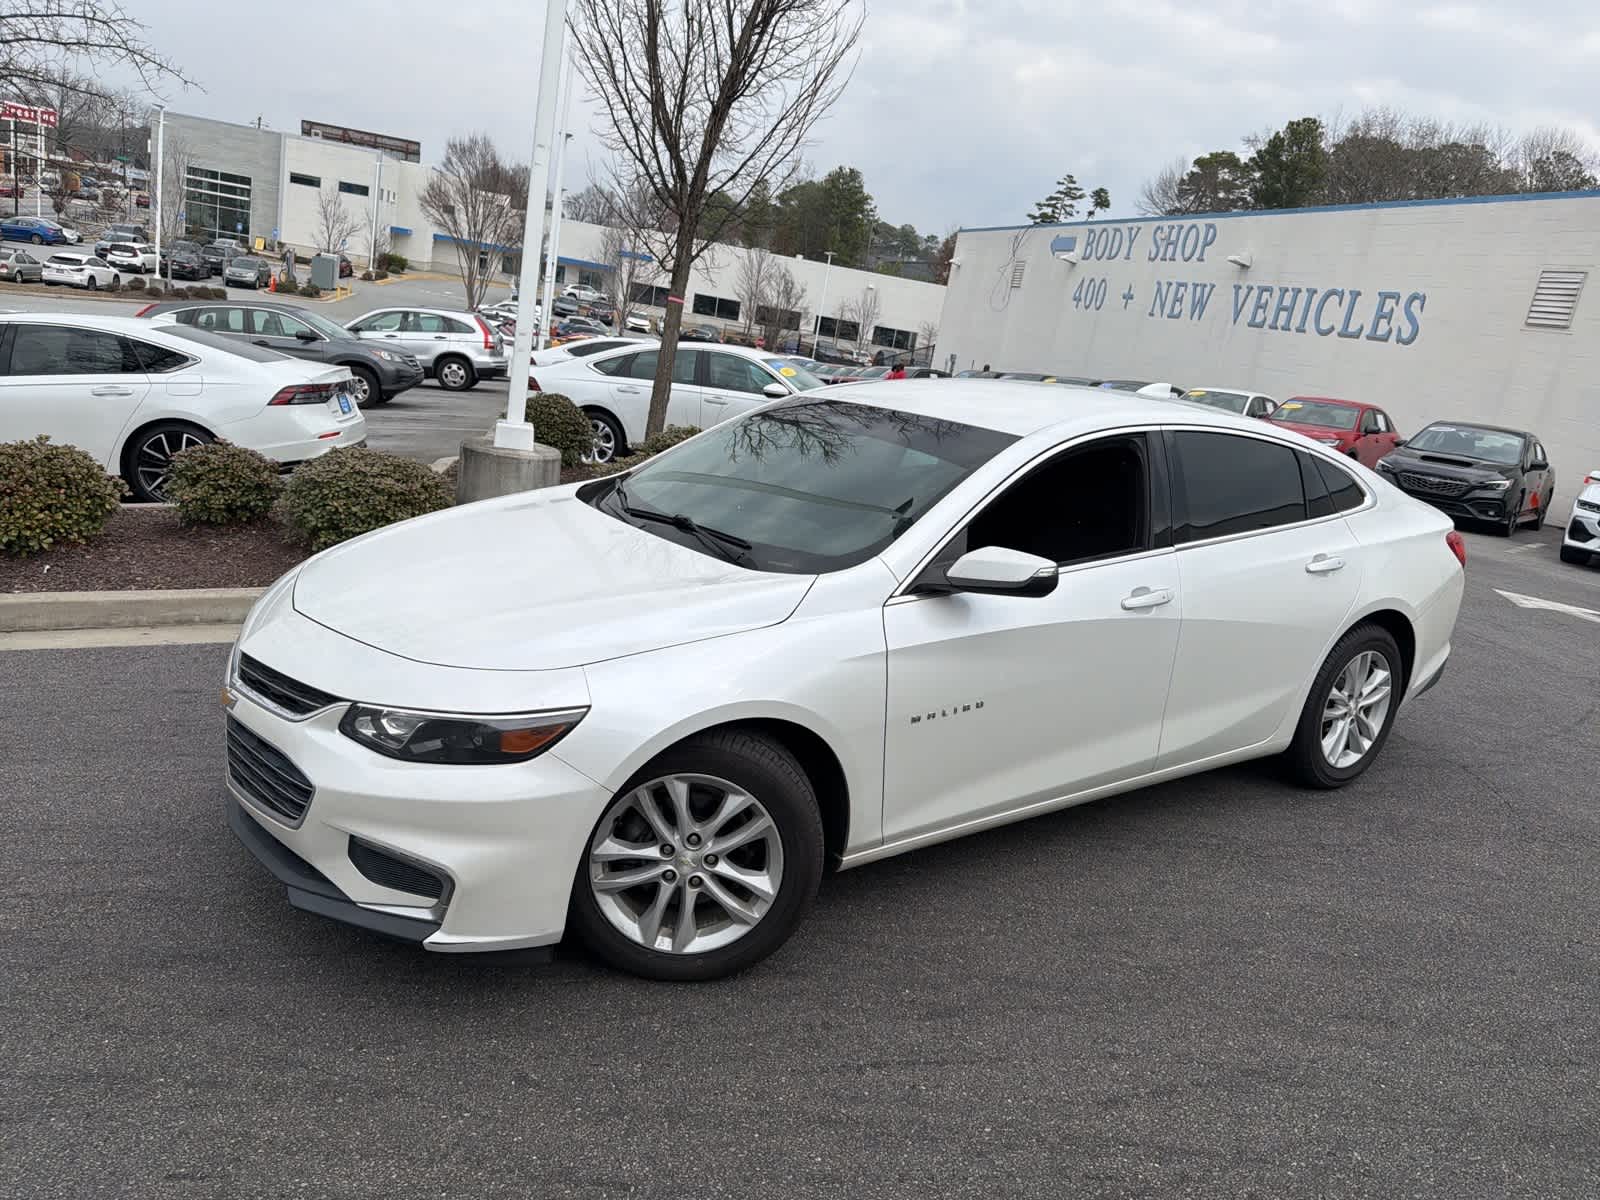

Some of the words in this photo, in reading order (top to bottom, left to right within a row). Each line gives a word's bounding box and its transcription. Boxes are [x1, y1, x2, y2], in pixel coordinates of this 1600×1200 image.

[1081, 226, 1142, 261] BODY
[1148, 223, 1217, 262] SHOP
[1072, 276, 1108, 311] 400
[1122, 283, 1134, 310] +
[1148, 280, 1216, 320] NEW
[1233, 284, 1427, 346] VEHICLES
[910, 700, 984, 724] MALIBU
